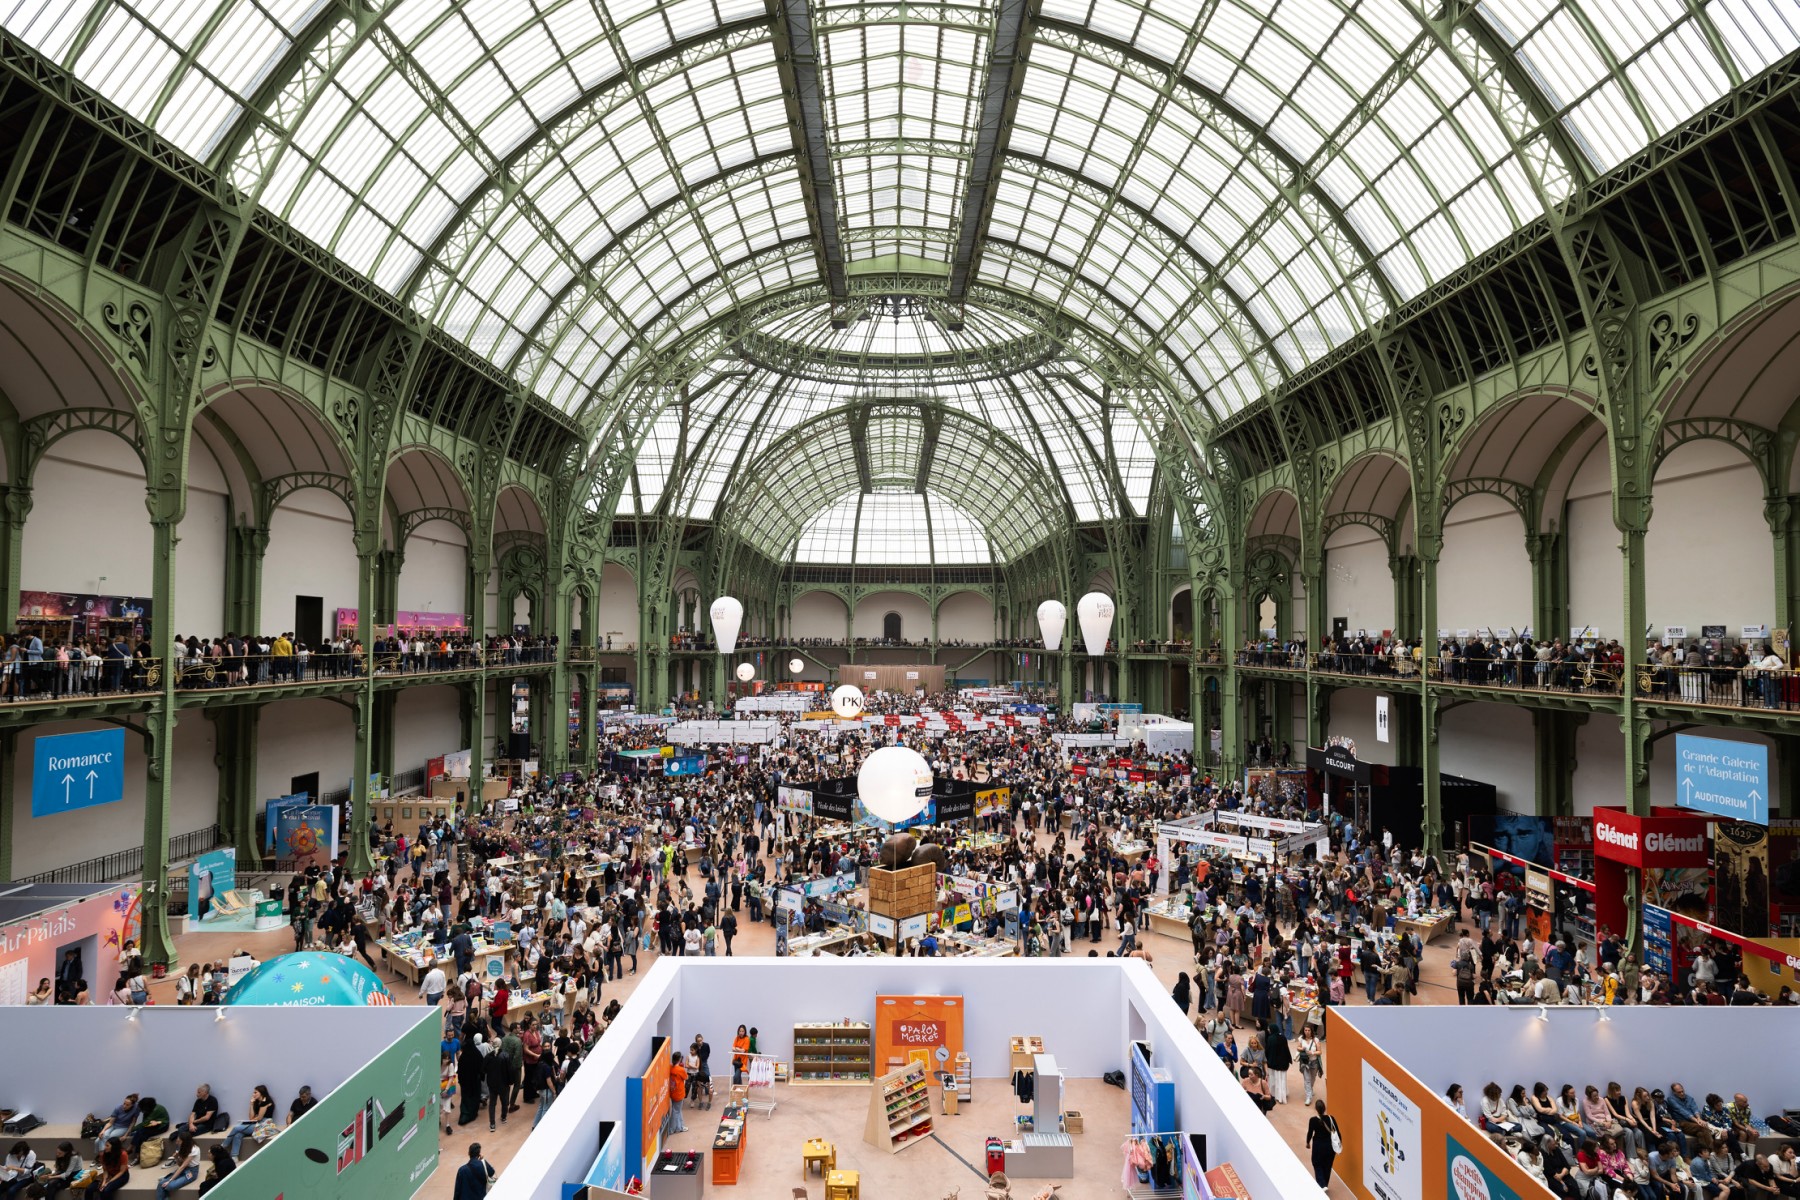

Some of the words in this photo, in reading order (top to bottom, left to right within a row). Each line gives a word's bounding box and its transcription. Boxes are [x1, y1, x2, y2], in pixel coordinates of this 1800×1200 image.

[49, 752, 112, 771] Romance
[1326, 758, 1355, 771] DELCOURT
[1682, 750, 1719, 764] Grande
[1722, 755, 1760, 770] Galerie
[1684, 763, 1696, 773] de
[1698, 764, 1759, 784] l'Adaptation
[1694, 791, 1747, 809] AUDITORIUM
[1596, 822, 1638, 850] Glénat
[1645, 833, 1704, 852] Glénat
[1528, 875, 1548, 890] Glénat
[27, 917, 76, 946] Palais
[1696, 923, 1712, 934] Glénat
[283, 995, 325, 1006] MAISON
[1464, 1165, 1482, 1186] petits
